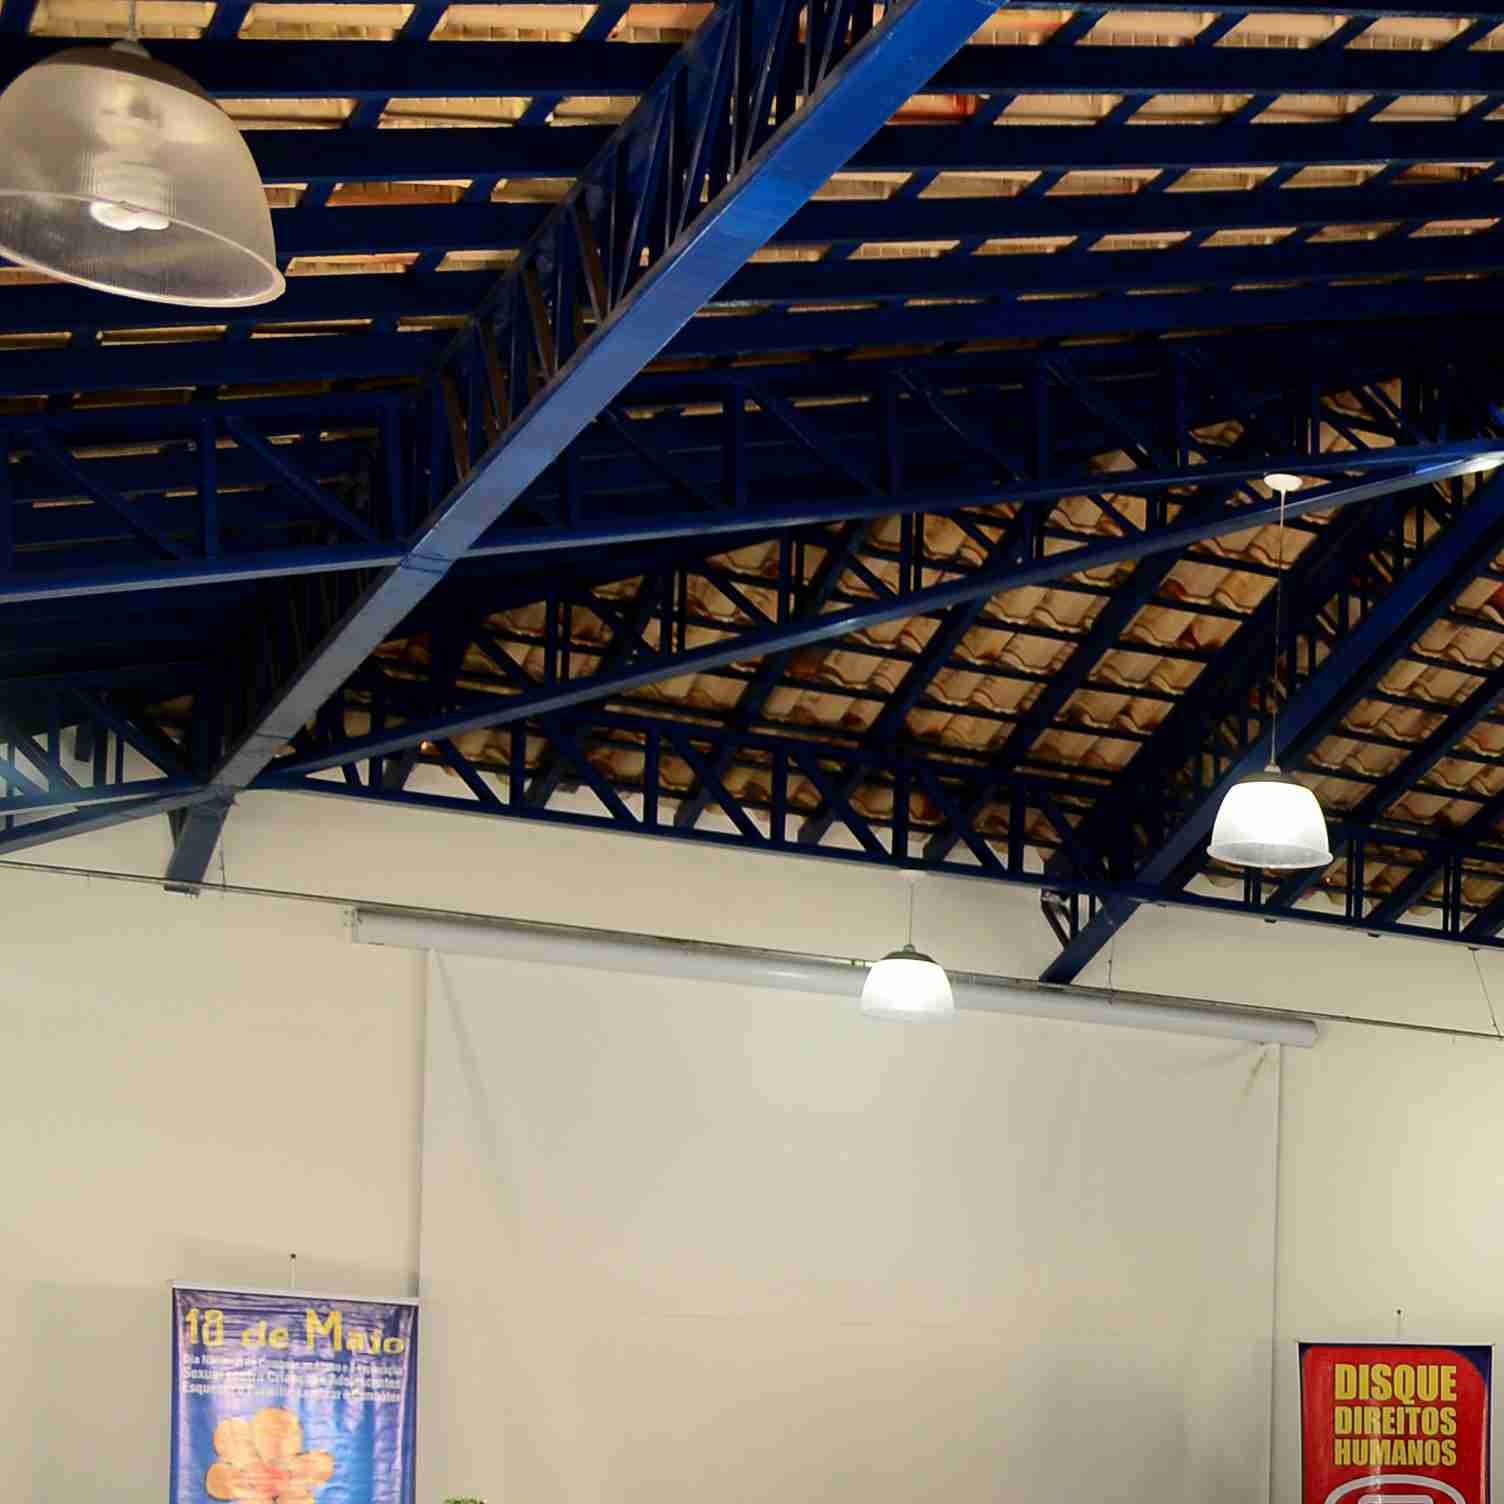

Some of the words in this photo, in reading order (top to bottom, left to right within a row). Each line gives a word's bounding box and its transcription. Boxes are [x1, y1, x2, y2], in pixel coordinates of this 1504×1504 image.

[185, 1307, 224, 1346] 18
[241, 1319, 289, 1349] de
[305, 1307, 405, 1355] Maio
[1334, 1363, 1457, 1404] DISQUE
[1334, 1406, 1457, 1435] DIREITOS
[1334, 1439, 1457, 1466] HUMANOS
